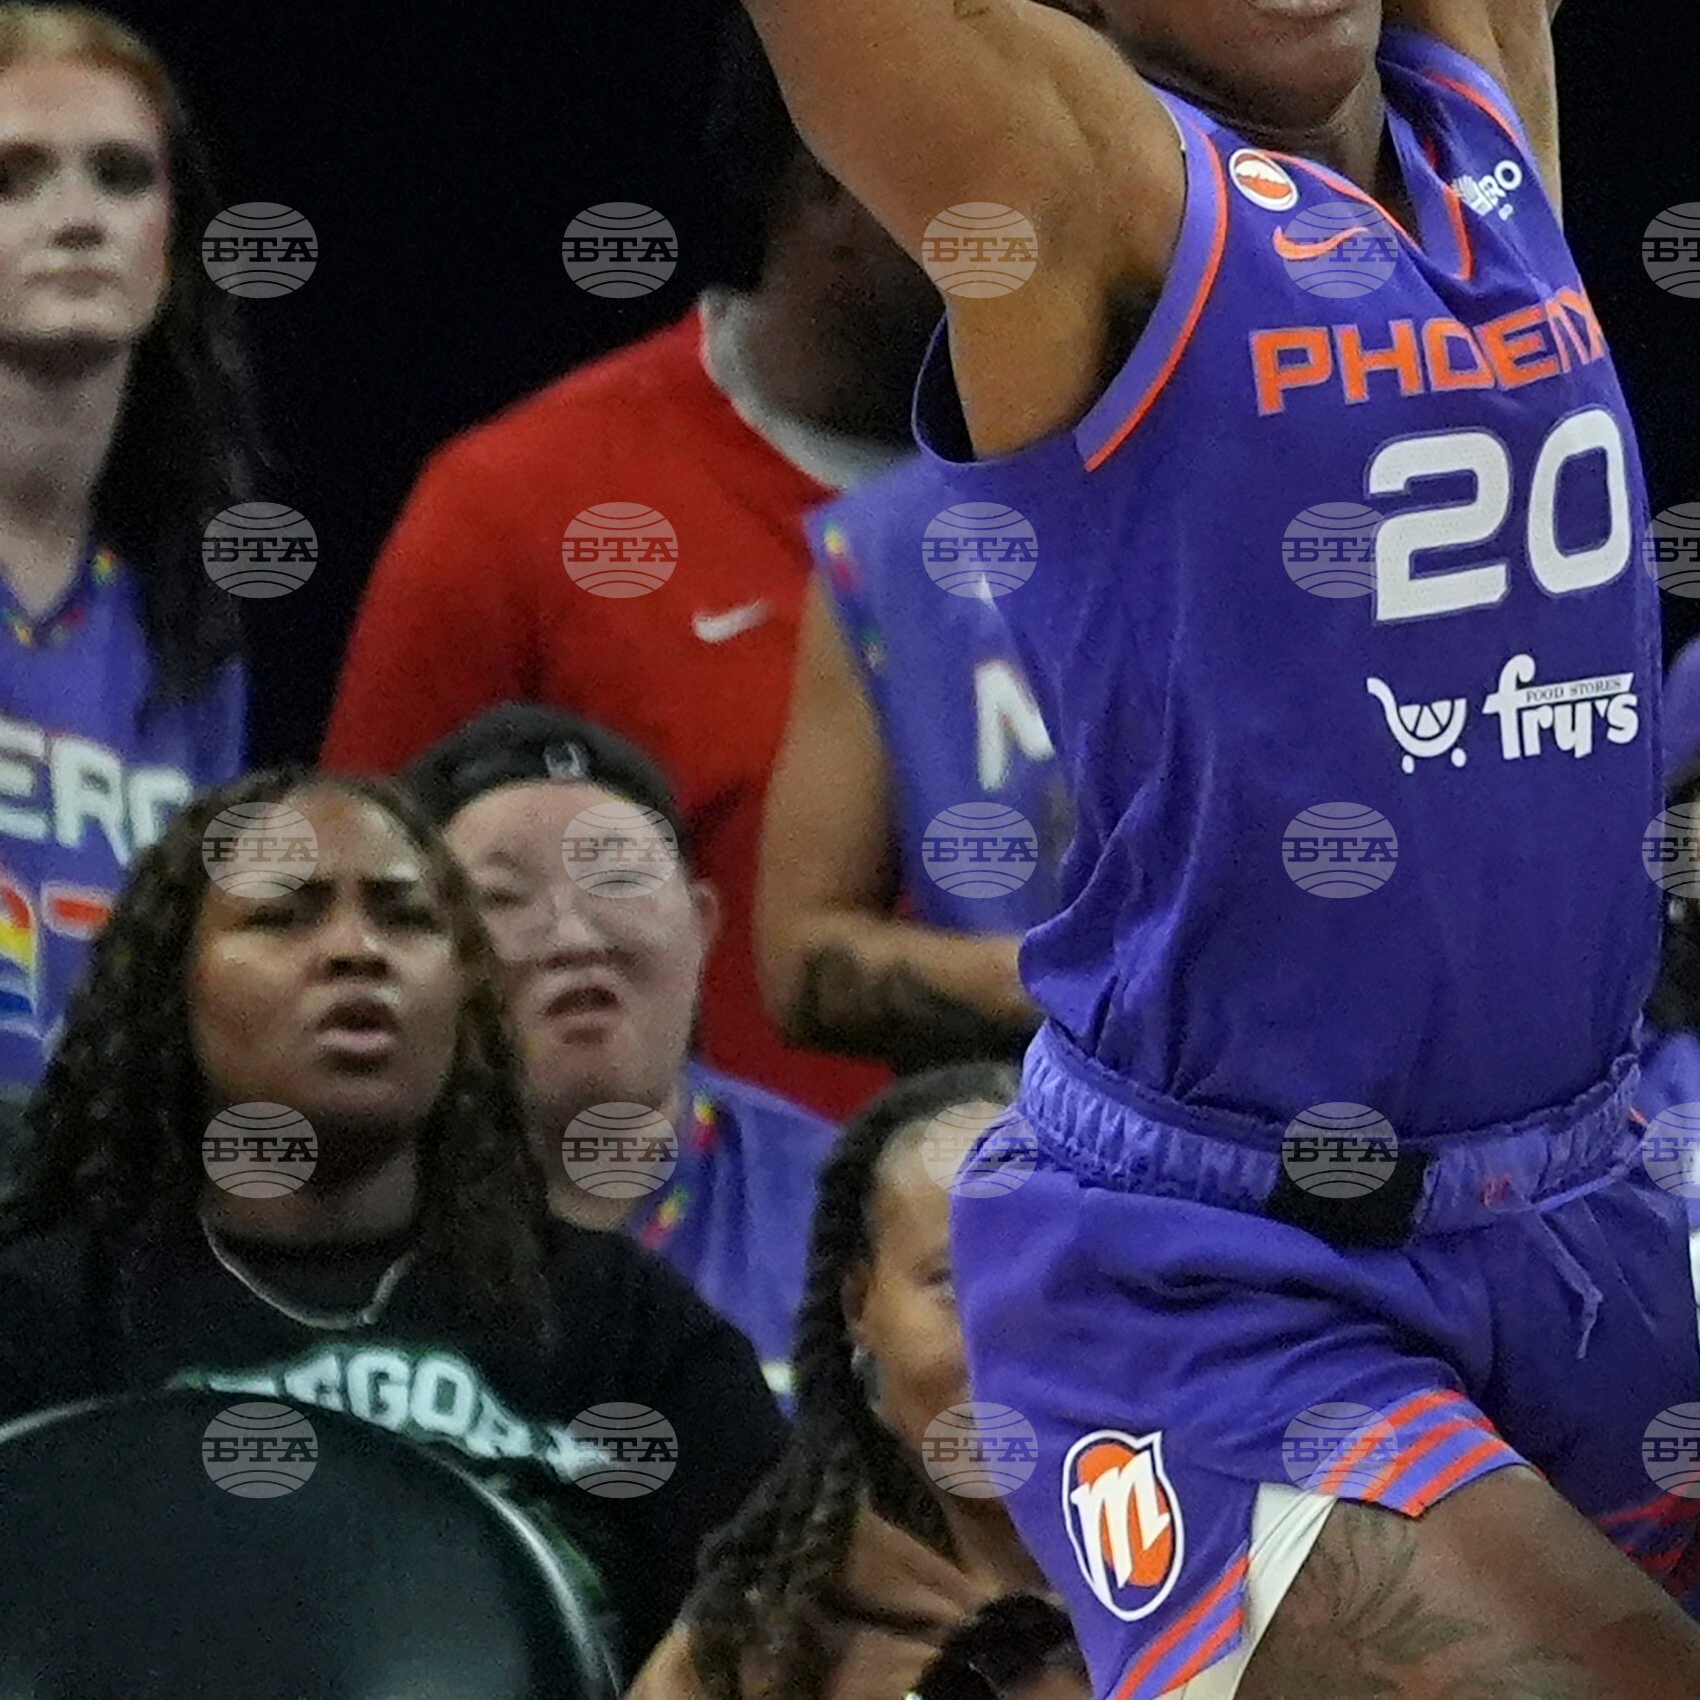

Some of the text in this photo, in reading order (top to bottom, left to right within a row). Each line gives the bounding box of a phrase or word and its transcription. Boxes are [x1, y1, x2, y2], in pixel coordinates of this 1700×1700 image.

[1365, 406, 1635, 626] 20
[1482, 653, 1640, 761] fry's
[1525, 677, 1623, 704] FOOD STORES
